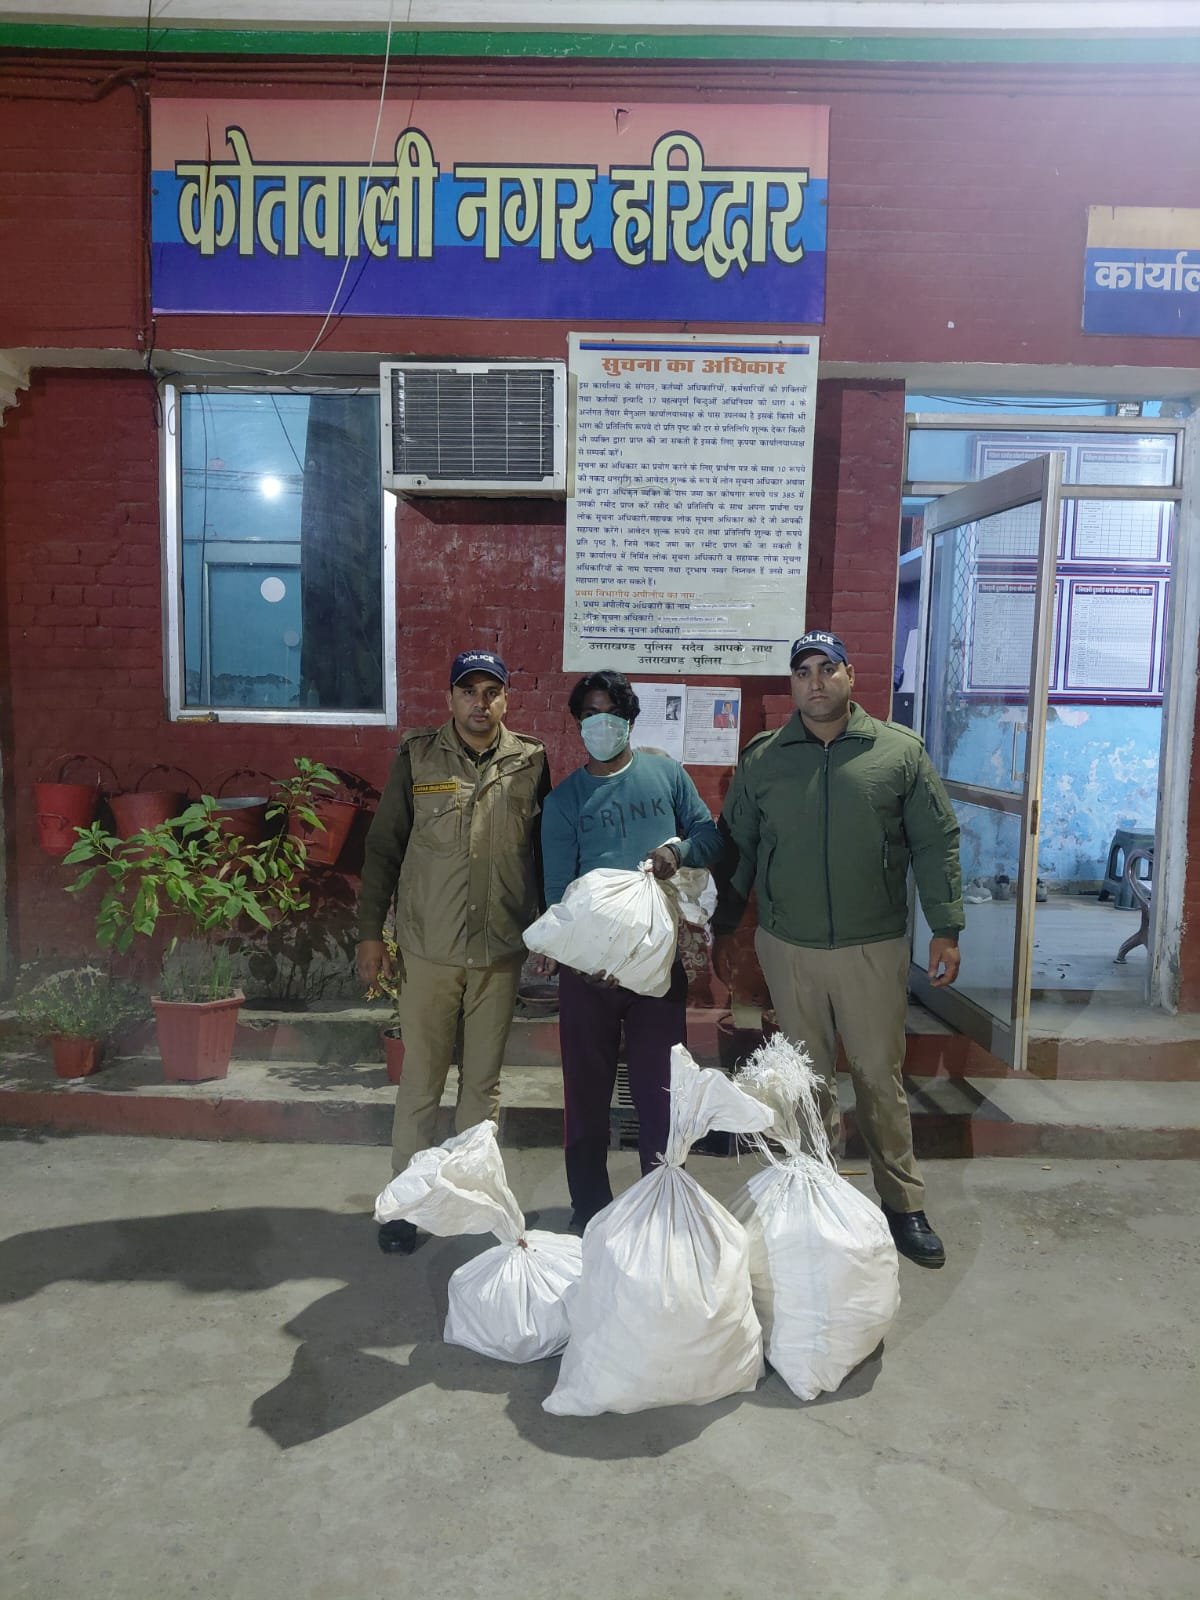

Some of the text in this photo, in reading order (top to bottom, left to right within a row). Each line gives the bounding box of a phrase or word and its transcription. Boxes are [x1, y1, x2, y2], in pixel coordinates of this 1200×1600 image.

[175, 126, 809, 279] कोतवाली नगर हरिद्वार
[666, 359, 694, 372] का
[701, 356, 787, 375] अधिकार
[587, 641, 636, 650] उत्तराखण्ड
[643, 641, 672, 653] पुलिस
[681, 641, 704, 652] सदैव
[713, 642, 743, 654] आपके
[796, 633, 834, 650] POLICE
[463, 654, 495, 664] POLICE
[638, 653, 722, 667] उत्तराखण्ड पुलिस
